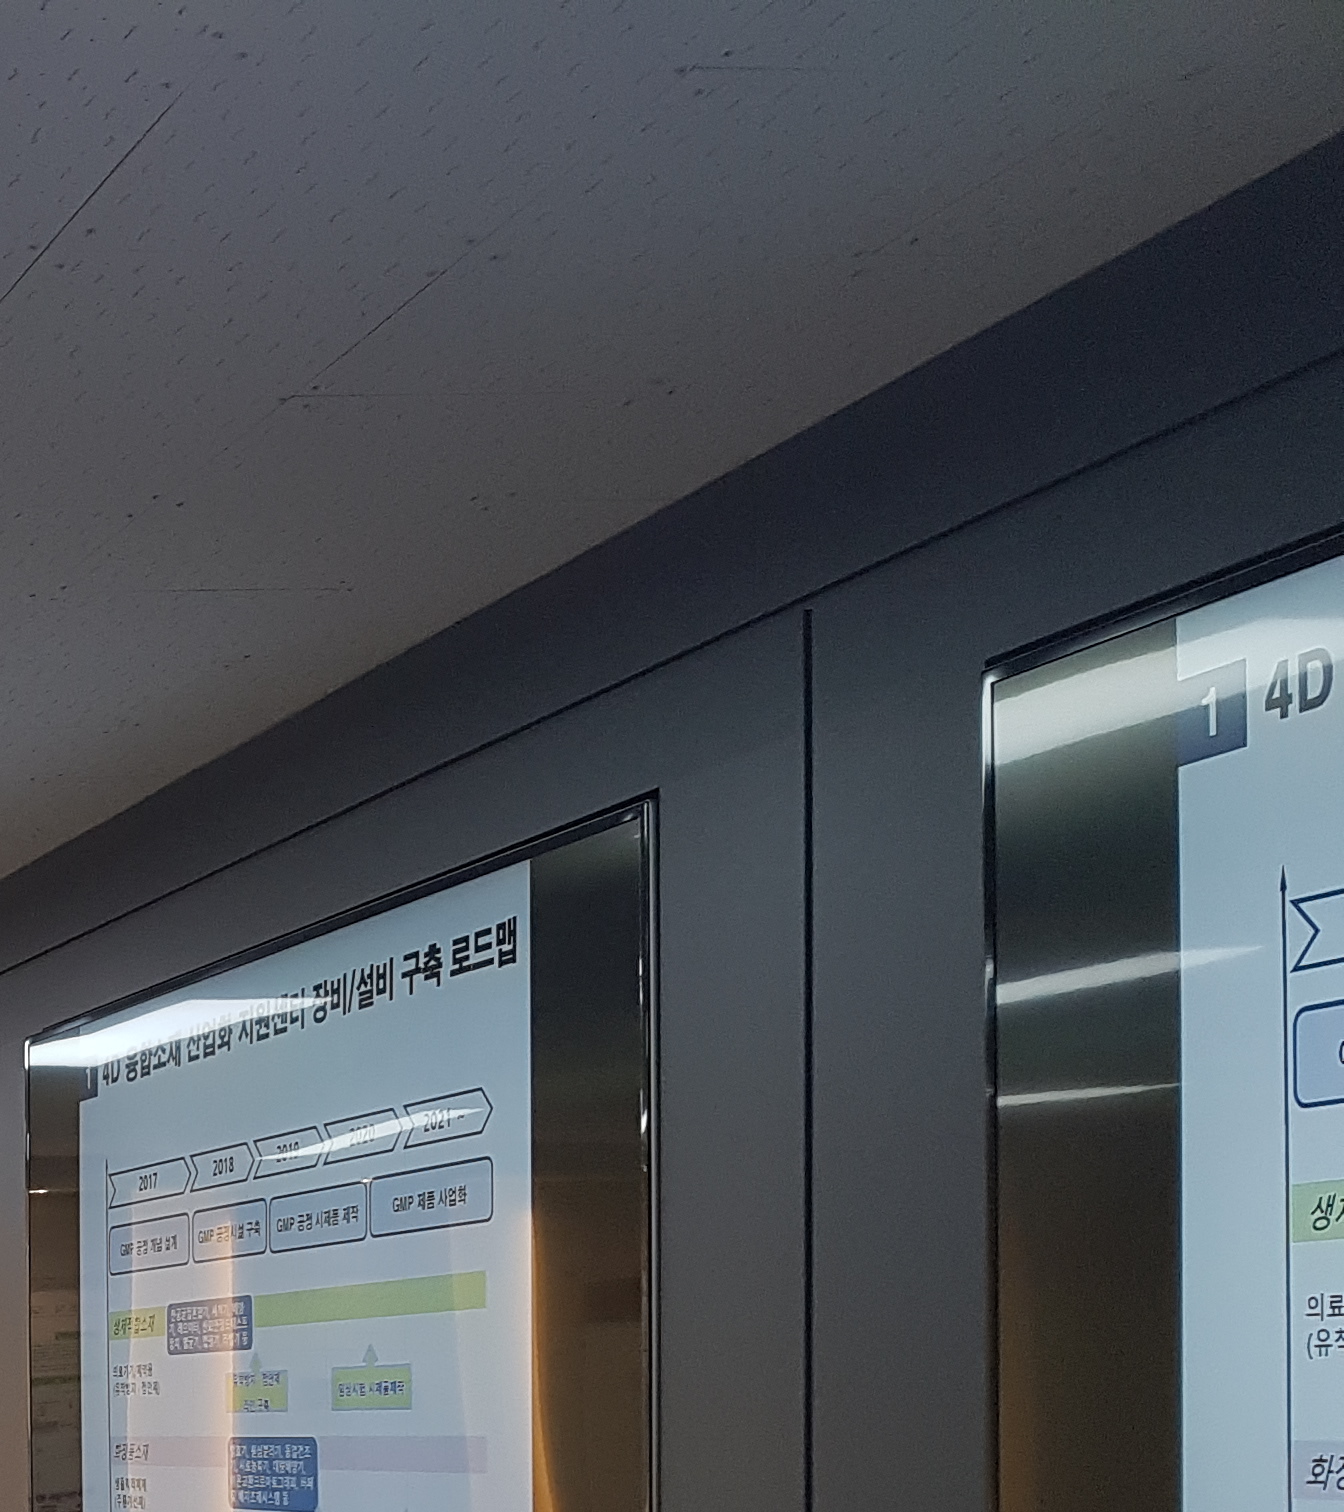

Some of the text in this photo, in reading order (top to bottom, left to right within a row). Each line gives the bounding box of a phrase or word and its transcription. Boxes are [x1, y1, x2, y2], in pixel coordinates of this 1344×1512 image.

[1201, 647, 1334, 737] 1 4D
[102, 1055, 121, 1087] 4D
[124, 1036, 183, 1084] 융합소재
[186, 1016, 234, 1063] 산업화
[238, 988, 307, 1045] 지원센터
[312, 956, 395, 1025] 장비/설비
[400, 942, 444, 996] 구축
[449, 916, 518, 979] 로드맵
[422, 1108, 453, 1133] 2021
[348, 1125, 376, 1148] 2020
[275, 1141, 301, 1164] 2019
[211, 1158, 235, 1178] 2018
[137, 1172, 159, 1192] 2017
[391, 1184, 469, 1214] GMP 제품 사업화
[197, 1229, 215, 1244] GMP
[245, 1219, 262, 1237] 구축
[275, 1204, 360, 1234] GMP 공정 시제품 제작
